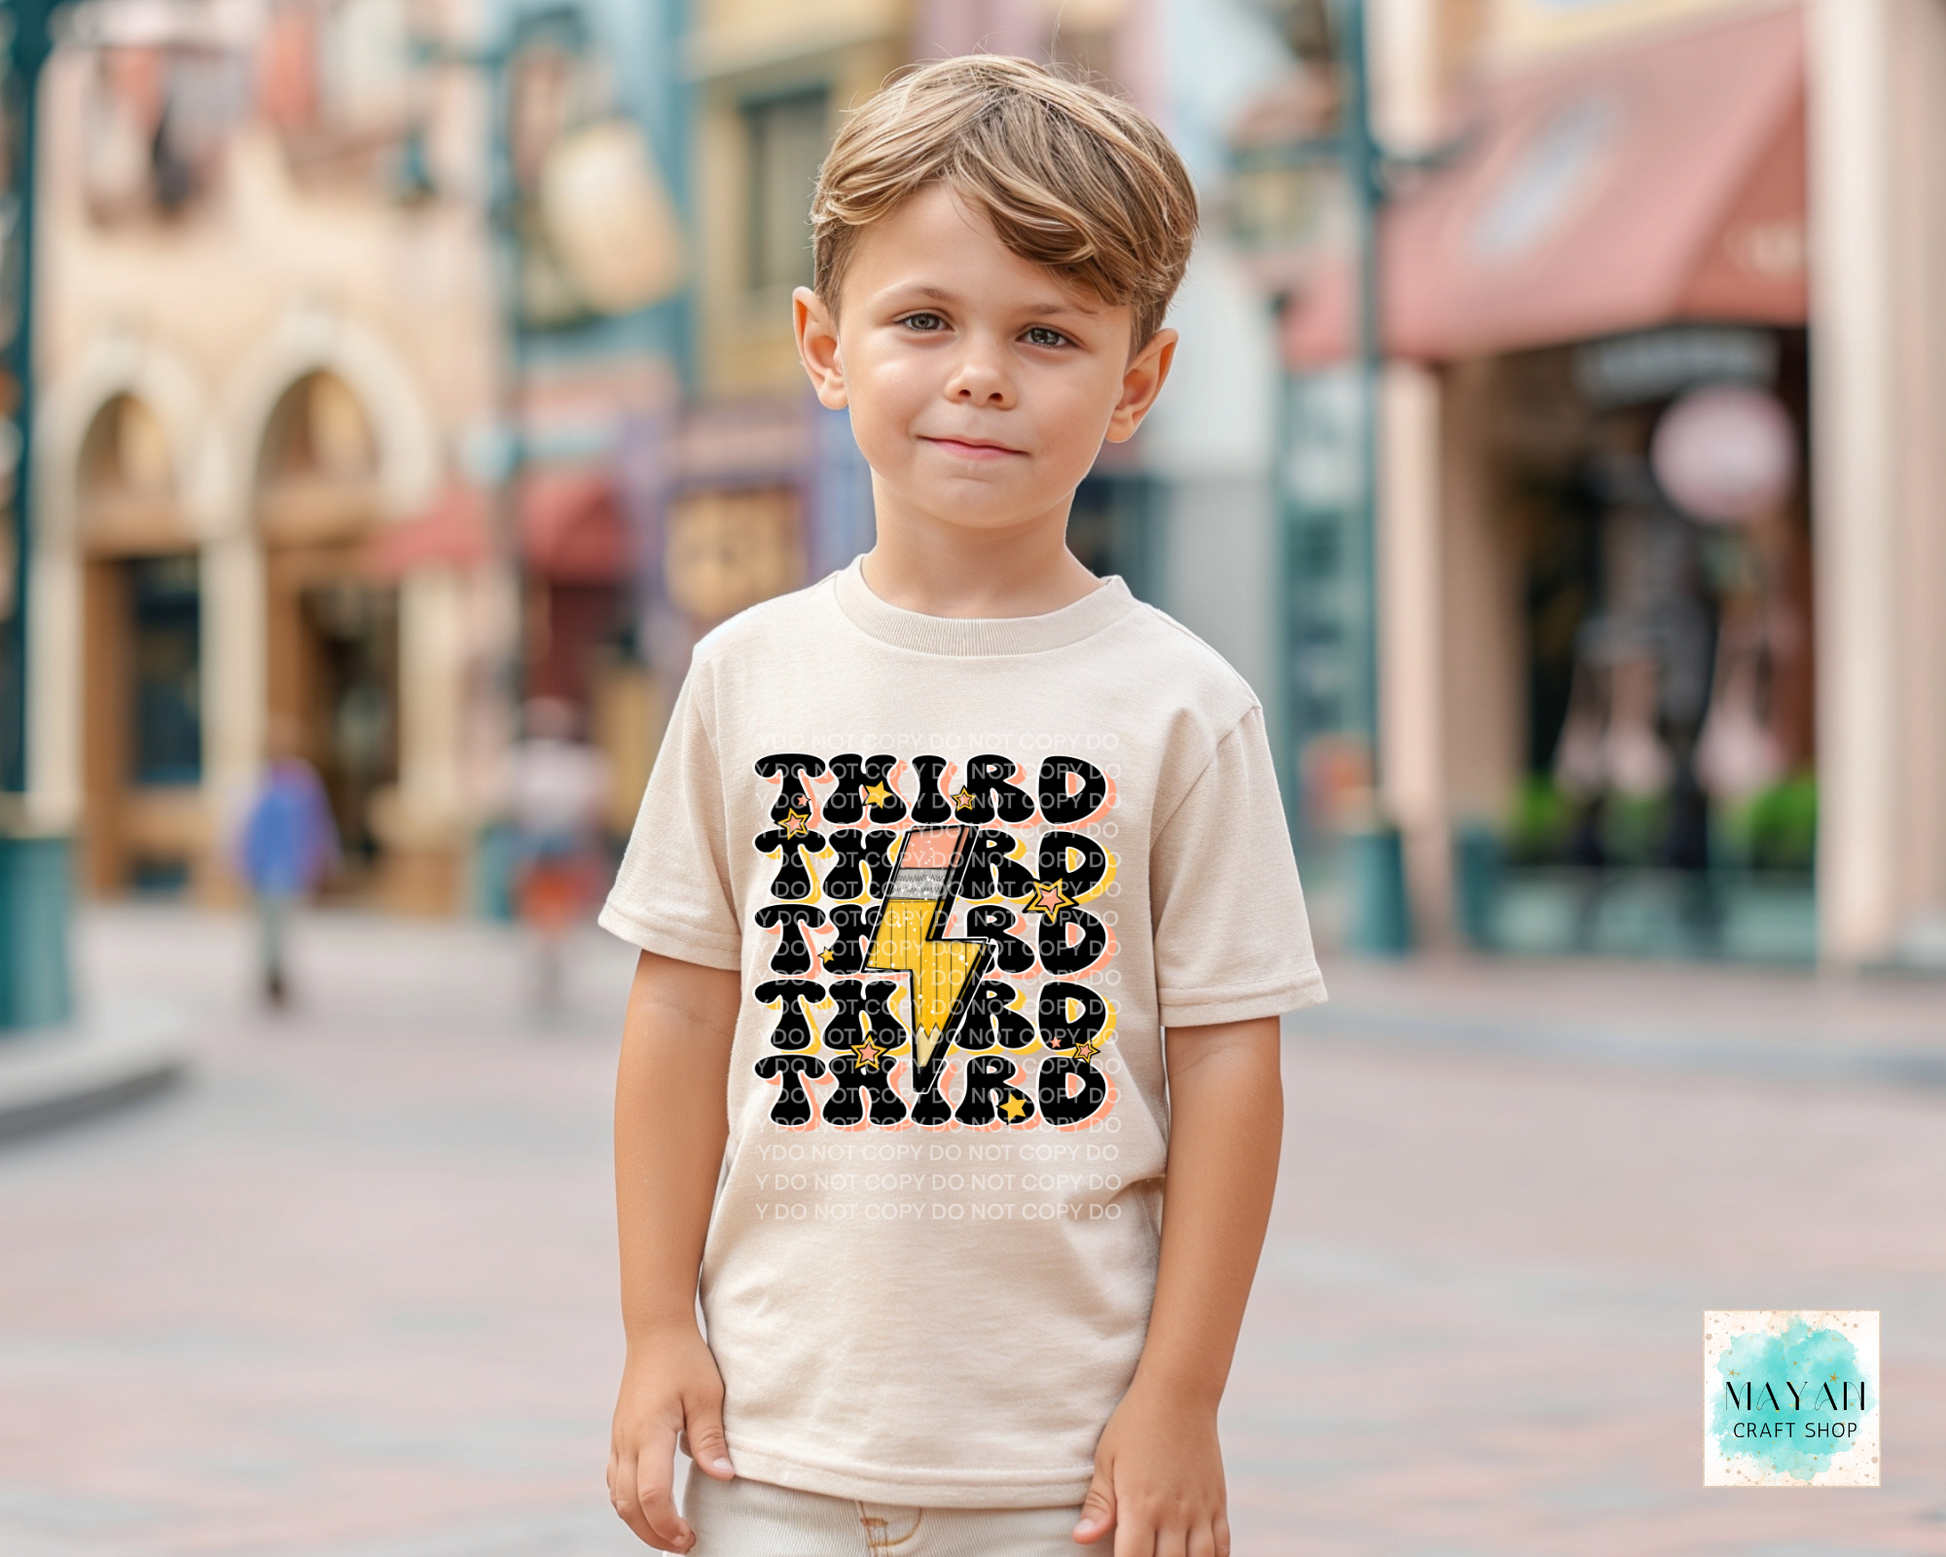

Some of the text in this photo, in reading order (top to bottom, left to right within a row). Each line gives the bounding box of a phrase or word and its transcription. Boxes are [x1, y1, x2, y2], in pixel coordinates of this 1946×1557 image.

[754, 753, 1107, 825] THIRD
[754, 829, 1107, 900] THRD
[754, 979, 1107, 1050] THRD
